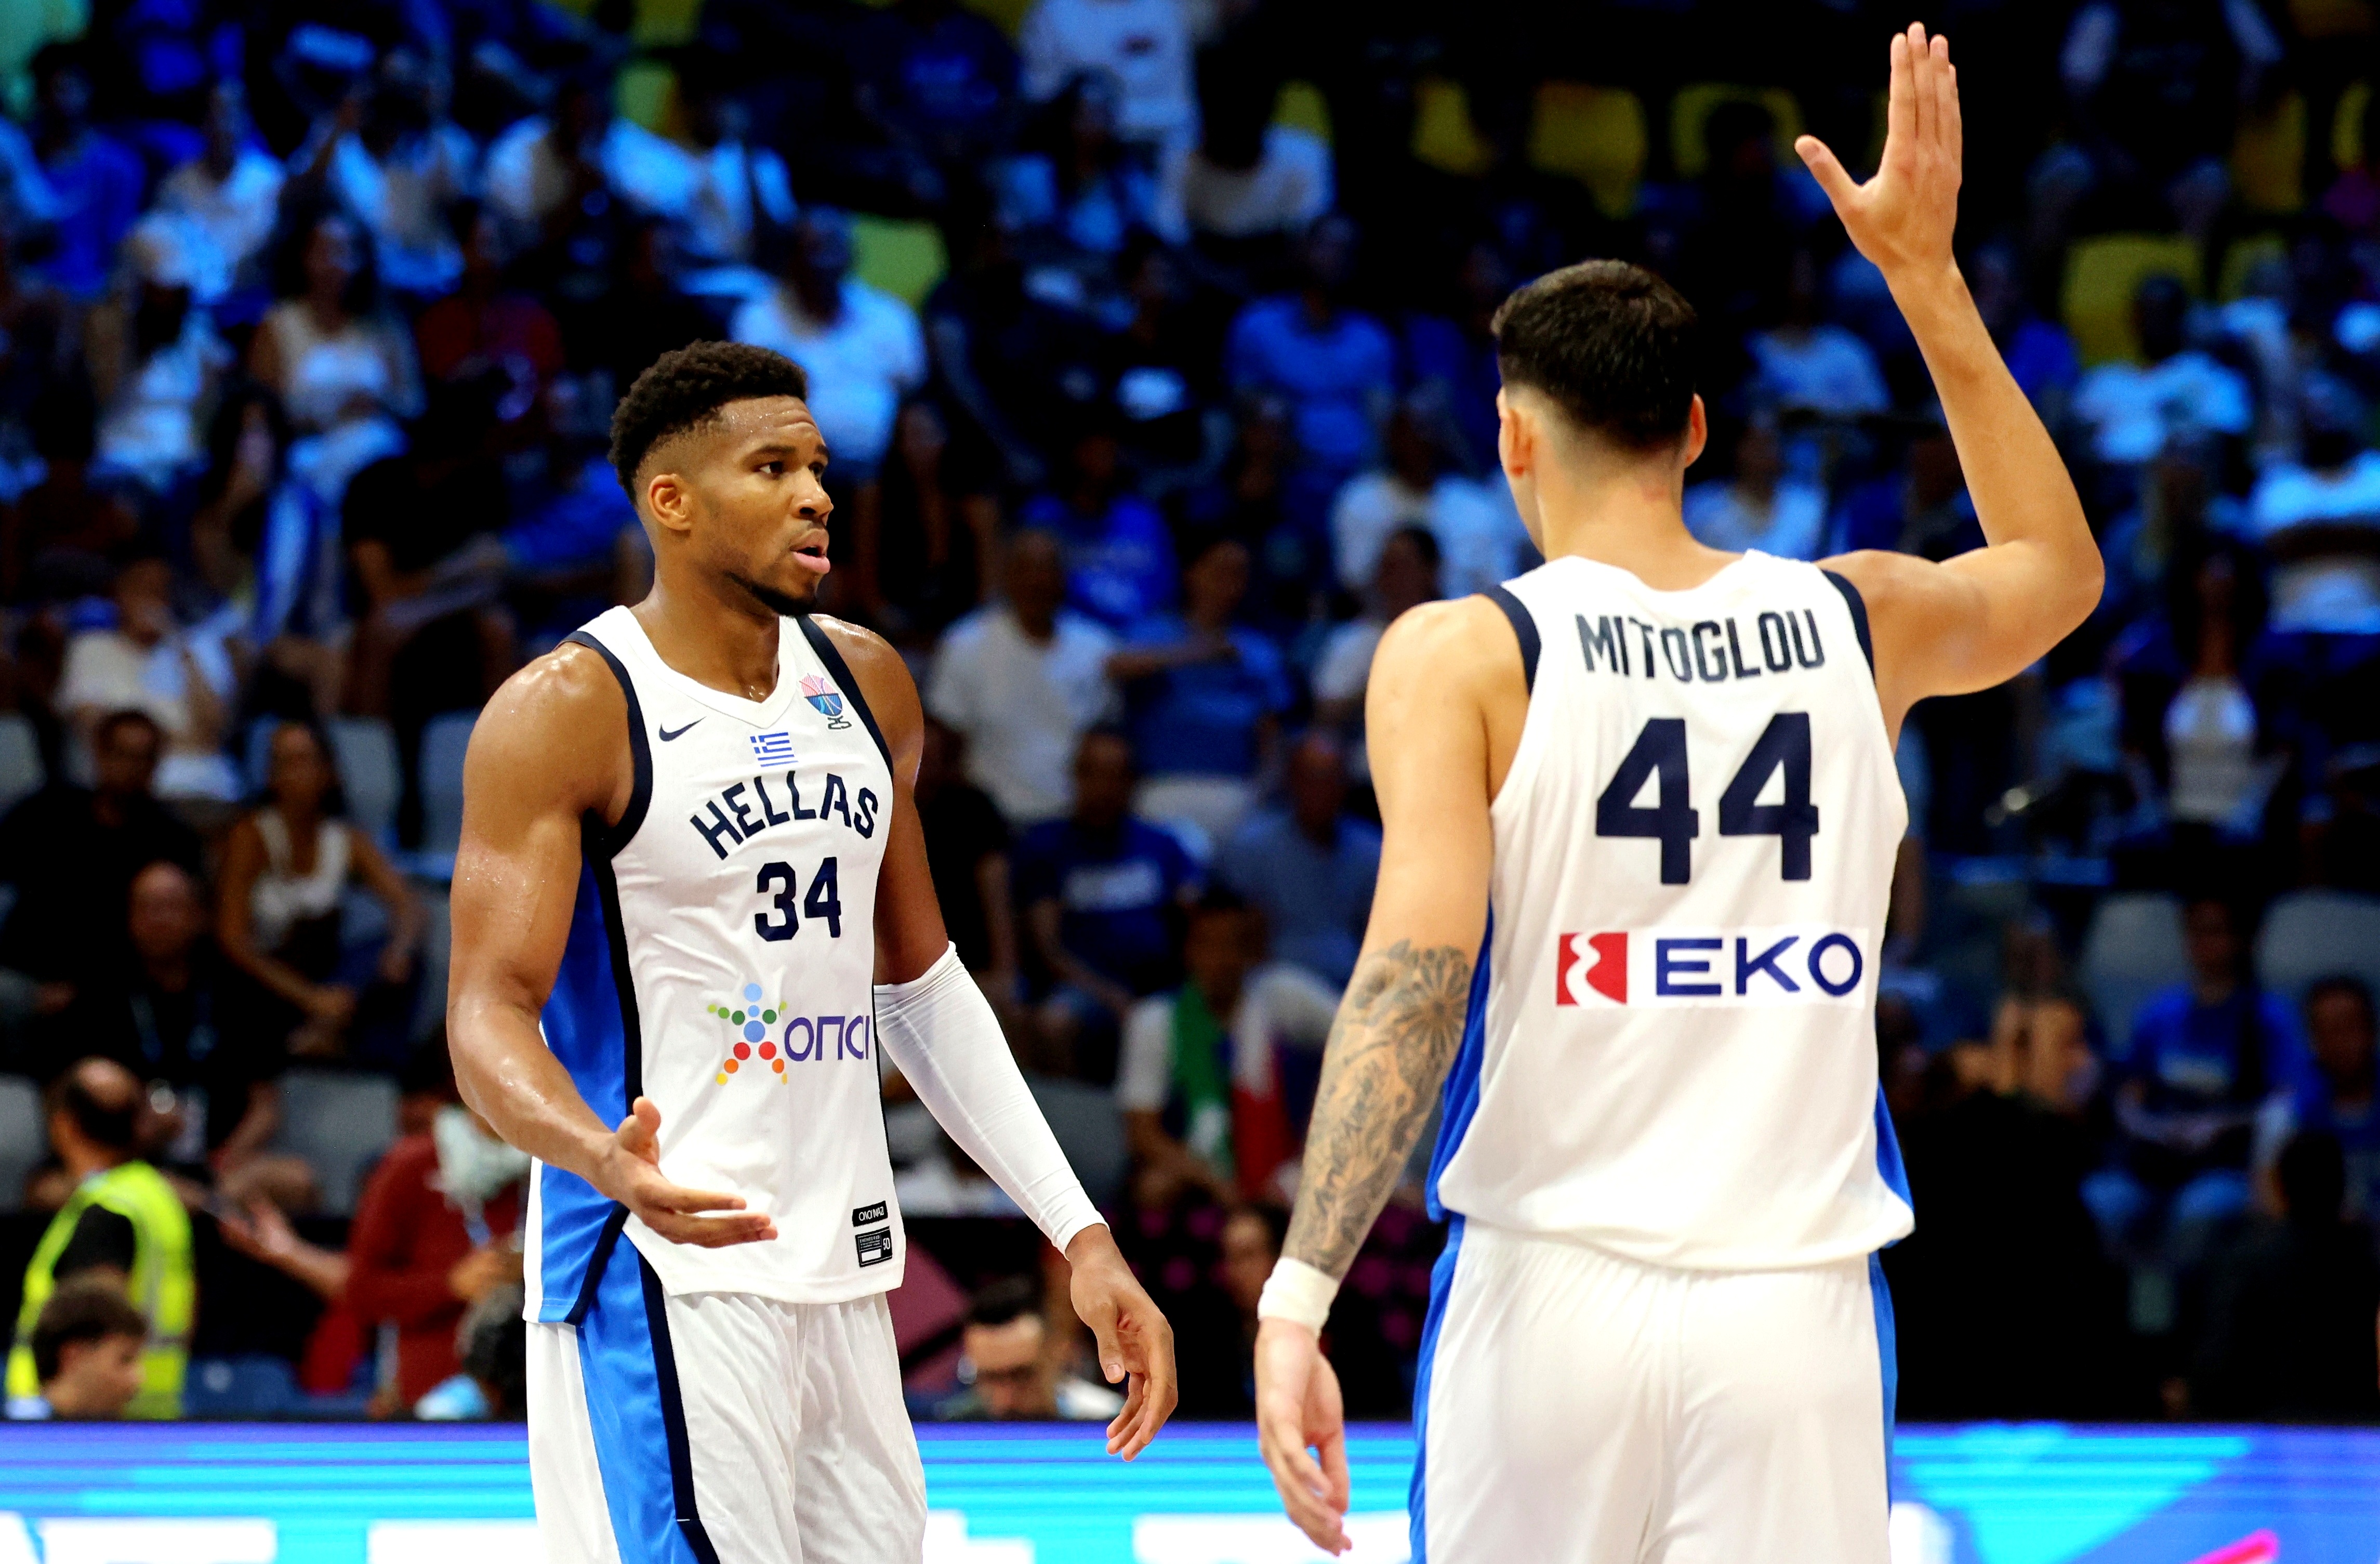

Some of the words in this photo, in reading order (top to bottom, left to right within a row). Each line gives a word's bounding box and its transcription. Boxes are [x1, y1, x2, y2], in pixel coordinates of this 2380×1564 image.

[1575, 609, 1826, 684] MITOGLOU
[690, 770, 878, 860] HELLAS
[1596, 711, 1819, 885] 44
[755, 856, 841, 942] 34
[1656, 932, 1863, 997] EKO
